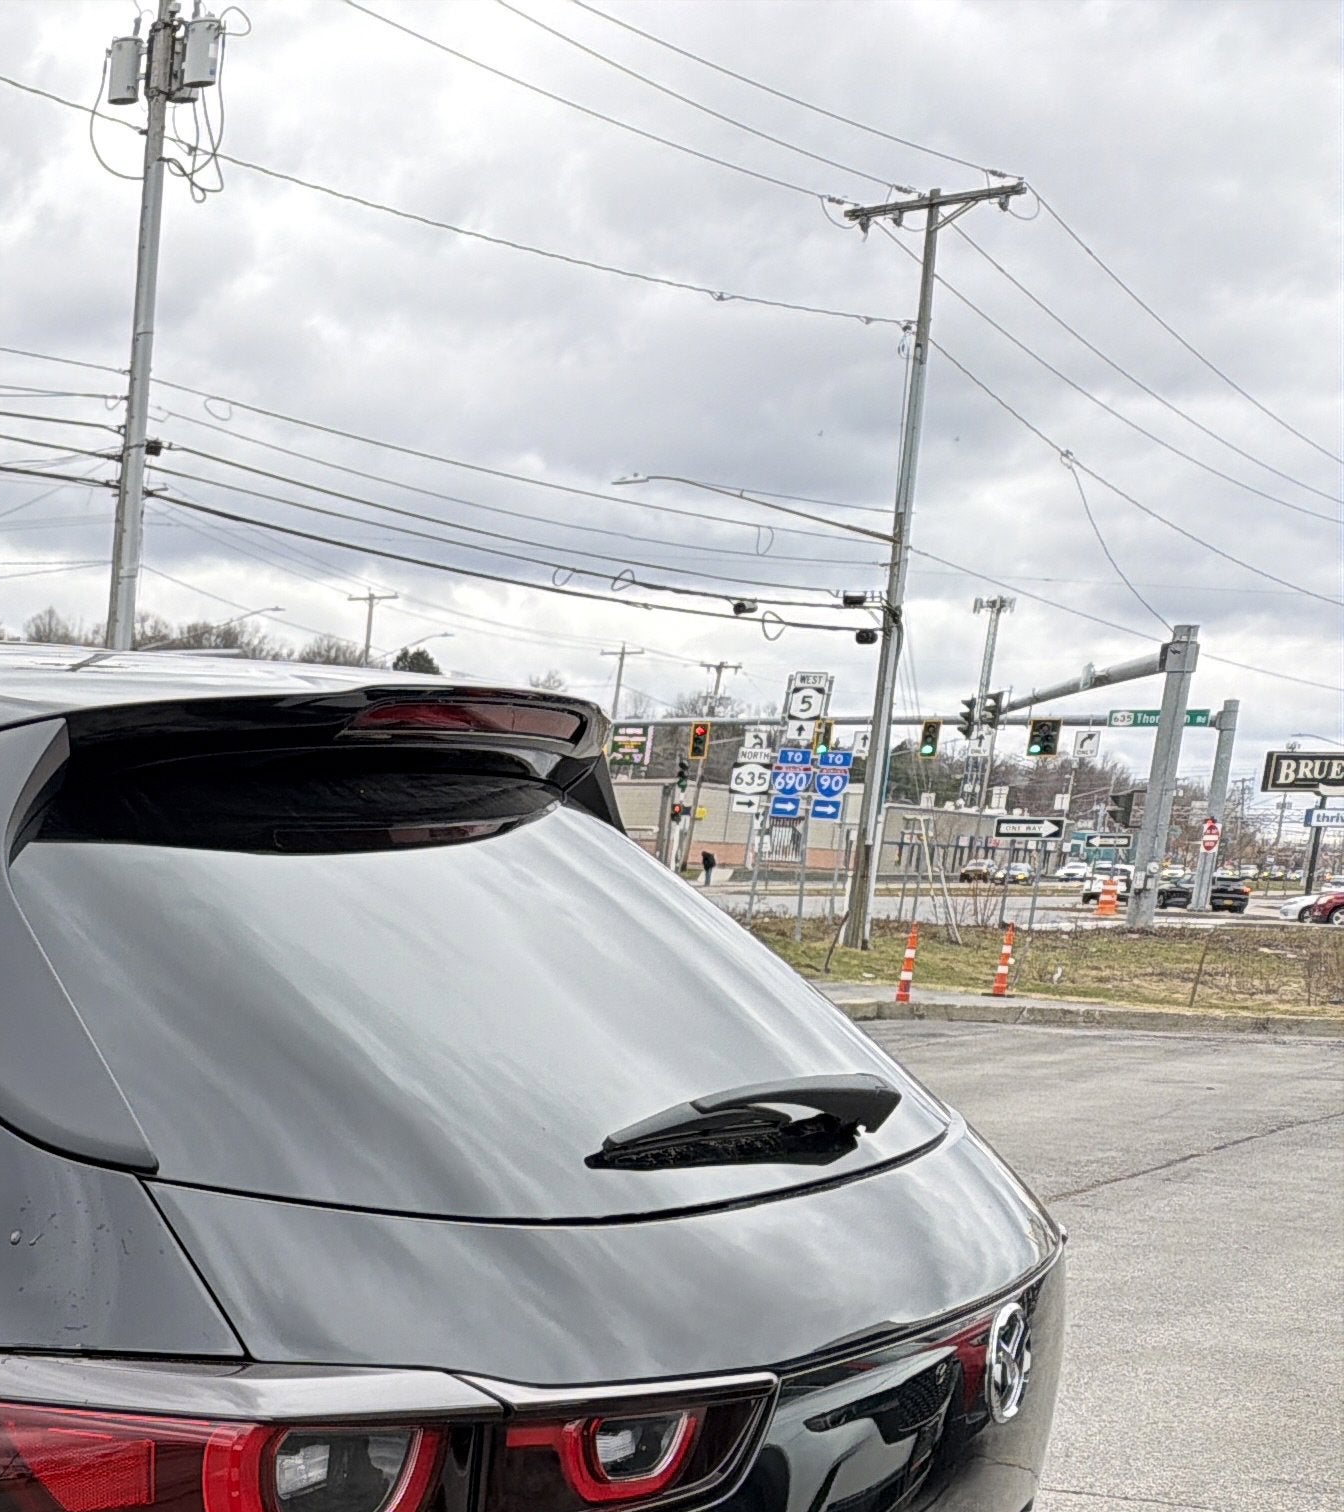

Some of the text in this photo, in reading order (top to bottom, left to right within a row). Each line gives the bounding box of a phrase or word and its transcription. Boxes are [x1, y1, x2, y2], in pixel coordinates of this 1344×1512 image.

[799, 674, 823, 685] WEST
[799, 695, 814, 713] 5
[1113, 714, 1132, 723] 635
[740, 750, 770, 760] NORTH
[787, 752, 803, 763] TO
[827, 753, 844, 764] TO
[733, 771, 768, 787] 635
[774, 773, 808, 791] 690
[819, 775, 844, 792] 90
